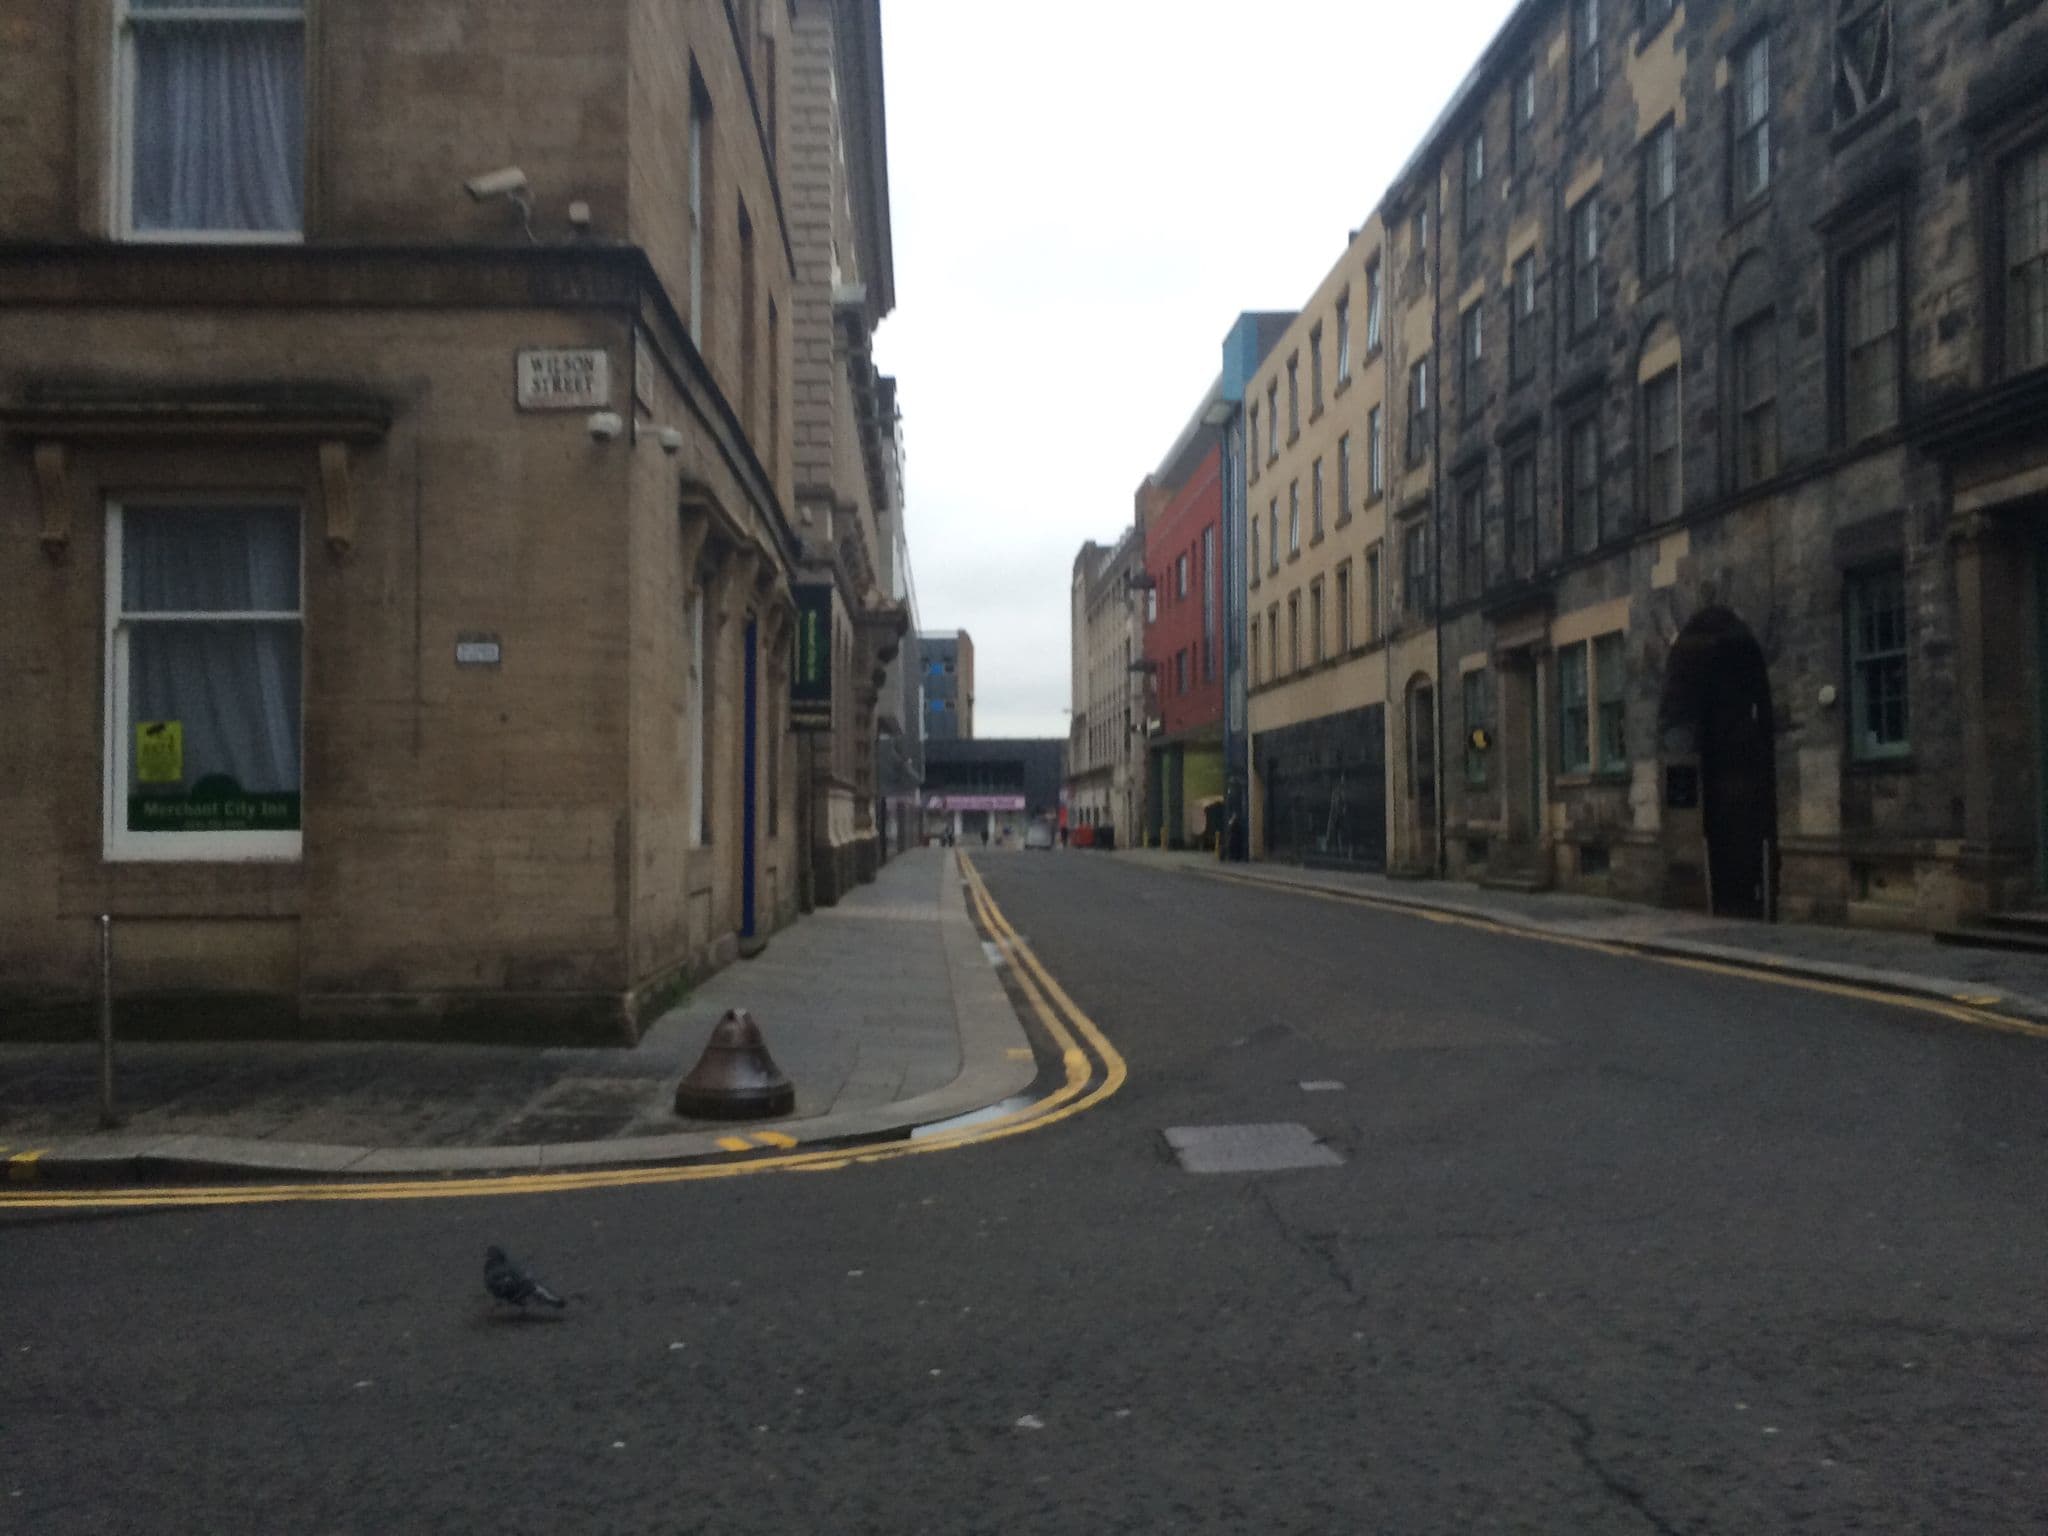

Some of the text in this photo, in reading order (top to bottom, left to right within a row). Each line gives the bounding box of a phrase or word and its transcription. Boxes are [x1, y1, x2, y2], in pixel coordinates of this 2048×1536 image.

[530, 357, 594, 372] WILSON
[531, 375, 593, 393] STREET
[143, 799, 288, 820] Merchant City Inn
